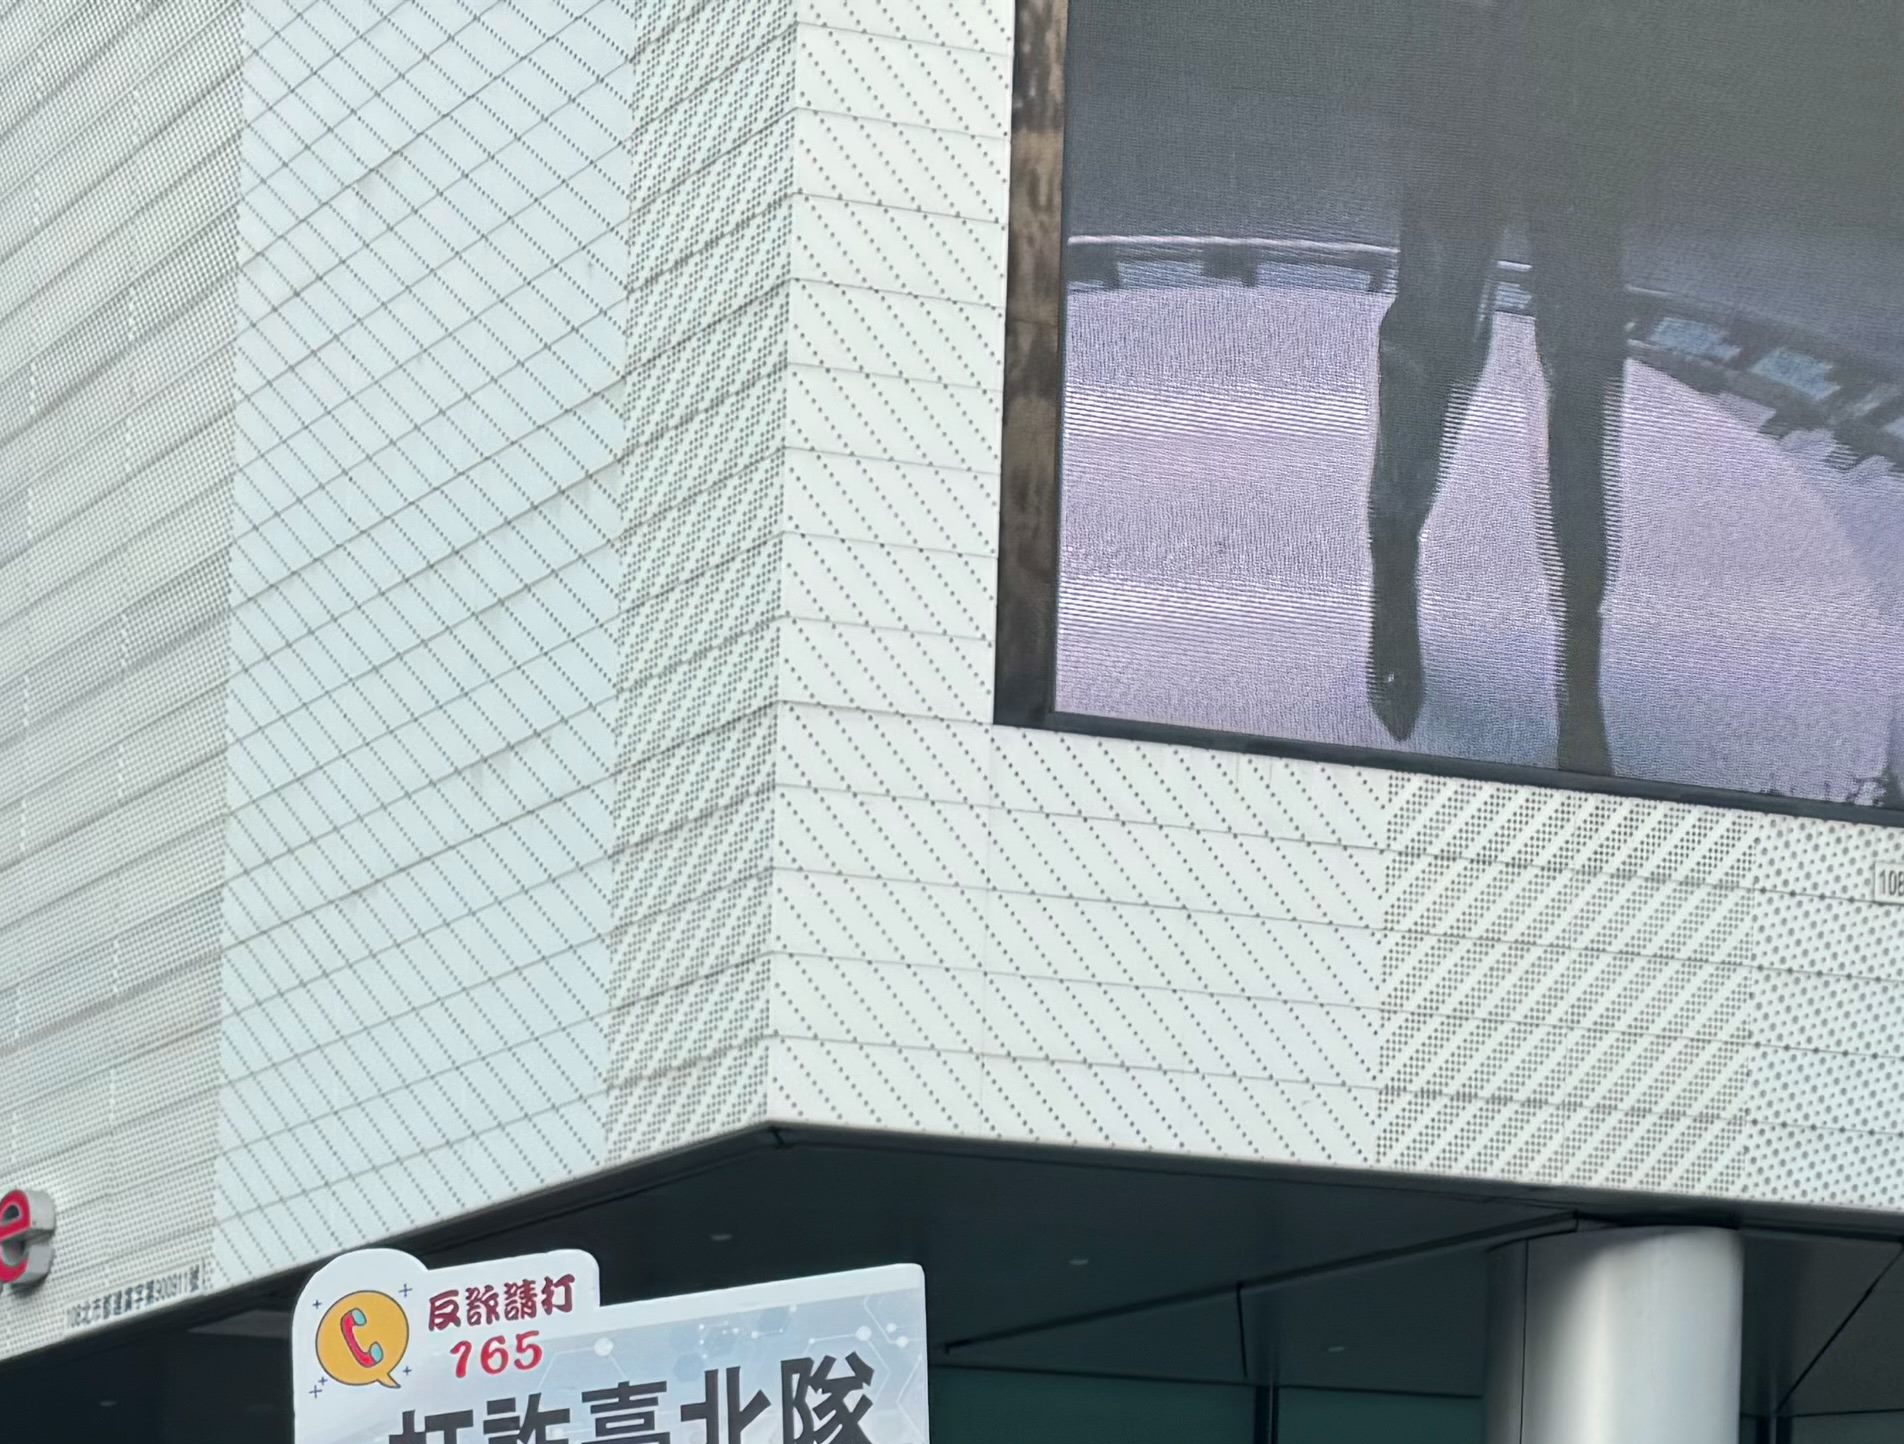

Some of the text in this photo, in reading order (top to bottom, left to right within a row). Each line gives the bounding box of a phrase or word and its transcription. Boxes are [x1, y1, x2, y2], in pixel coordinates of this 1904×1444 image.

[428, 1273, 576, 1331] 反詐請打
[450, 1330, 543, 1379] 165
